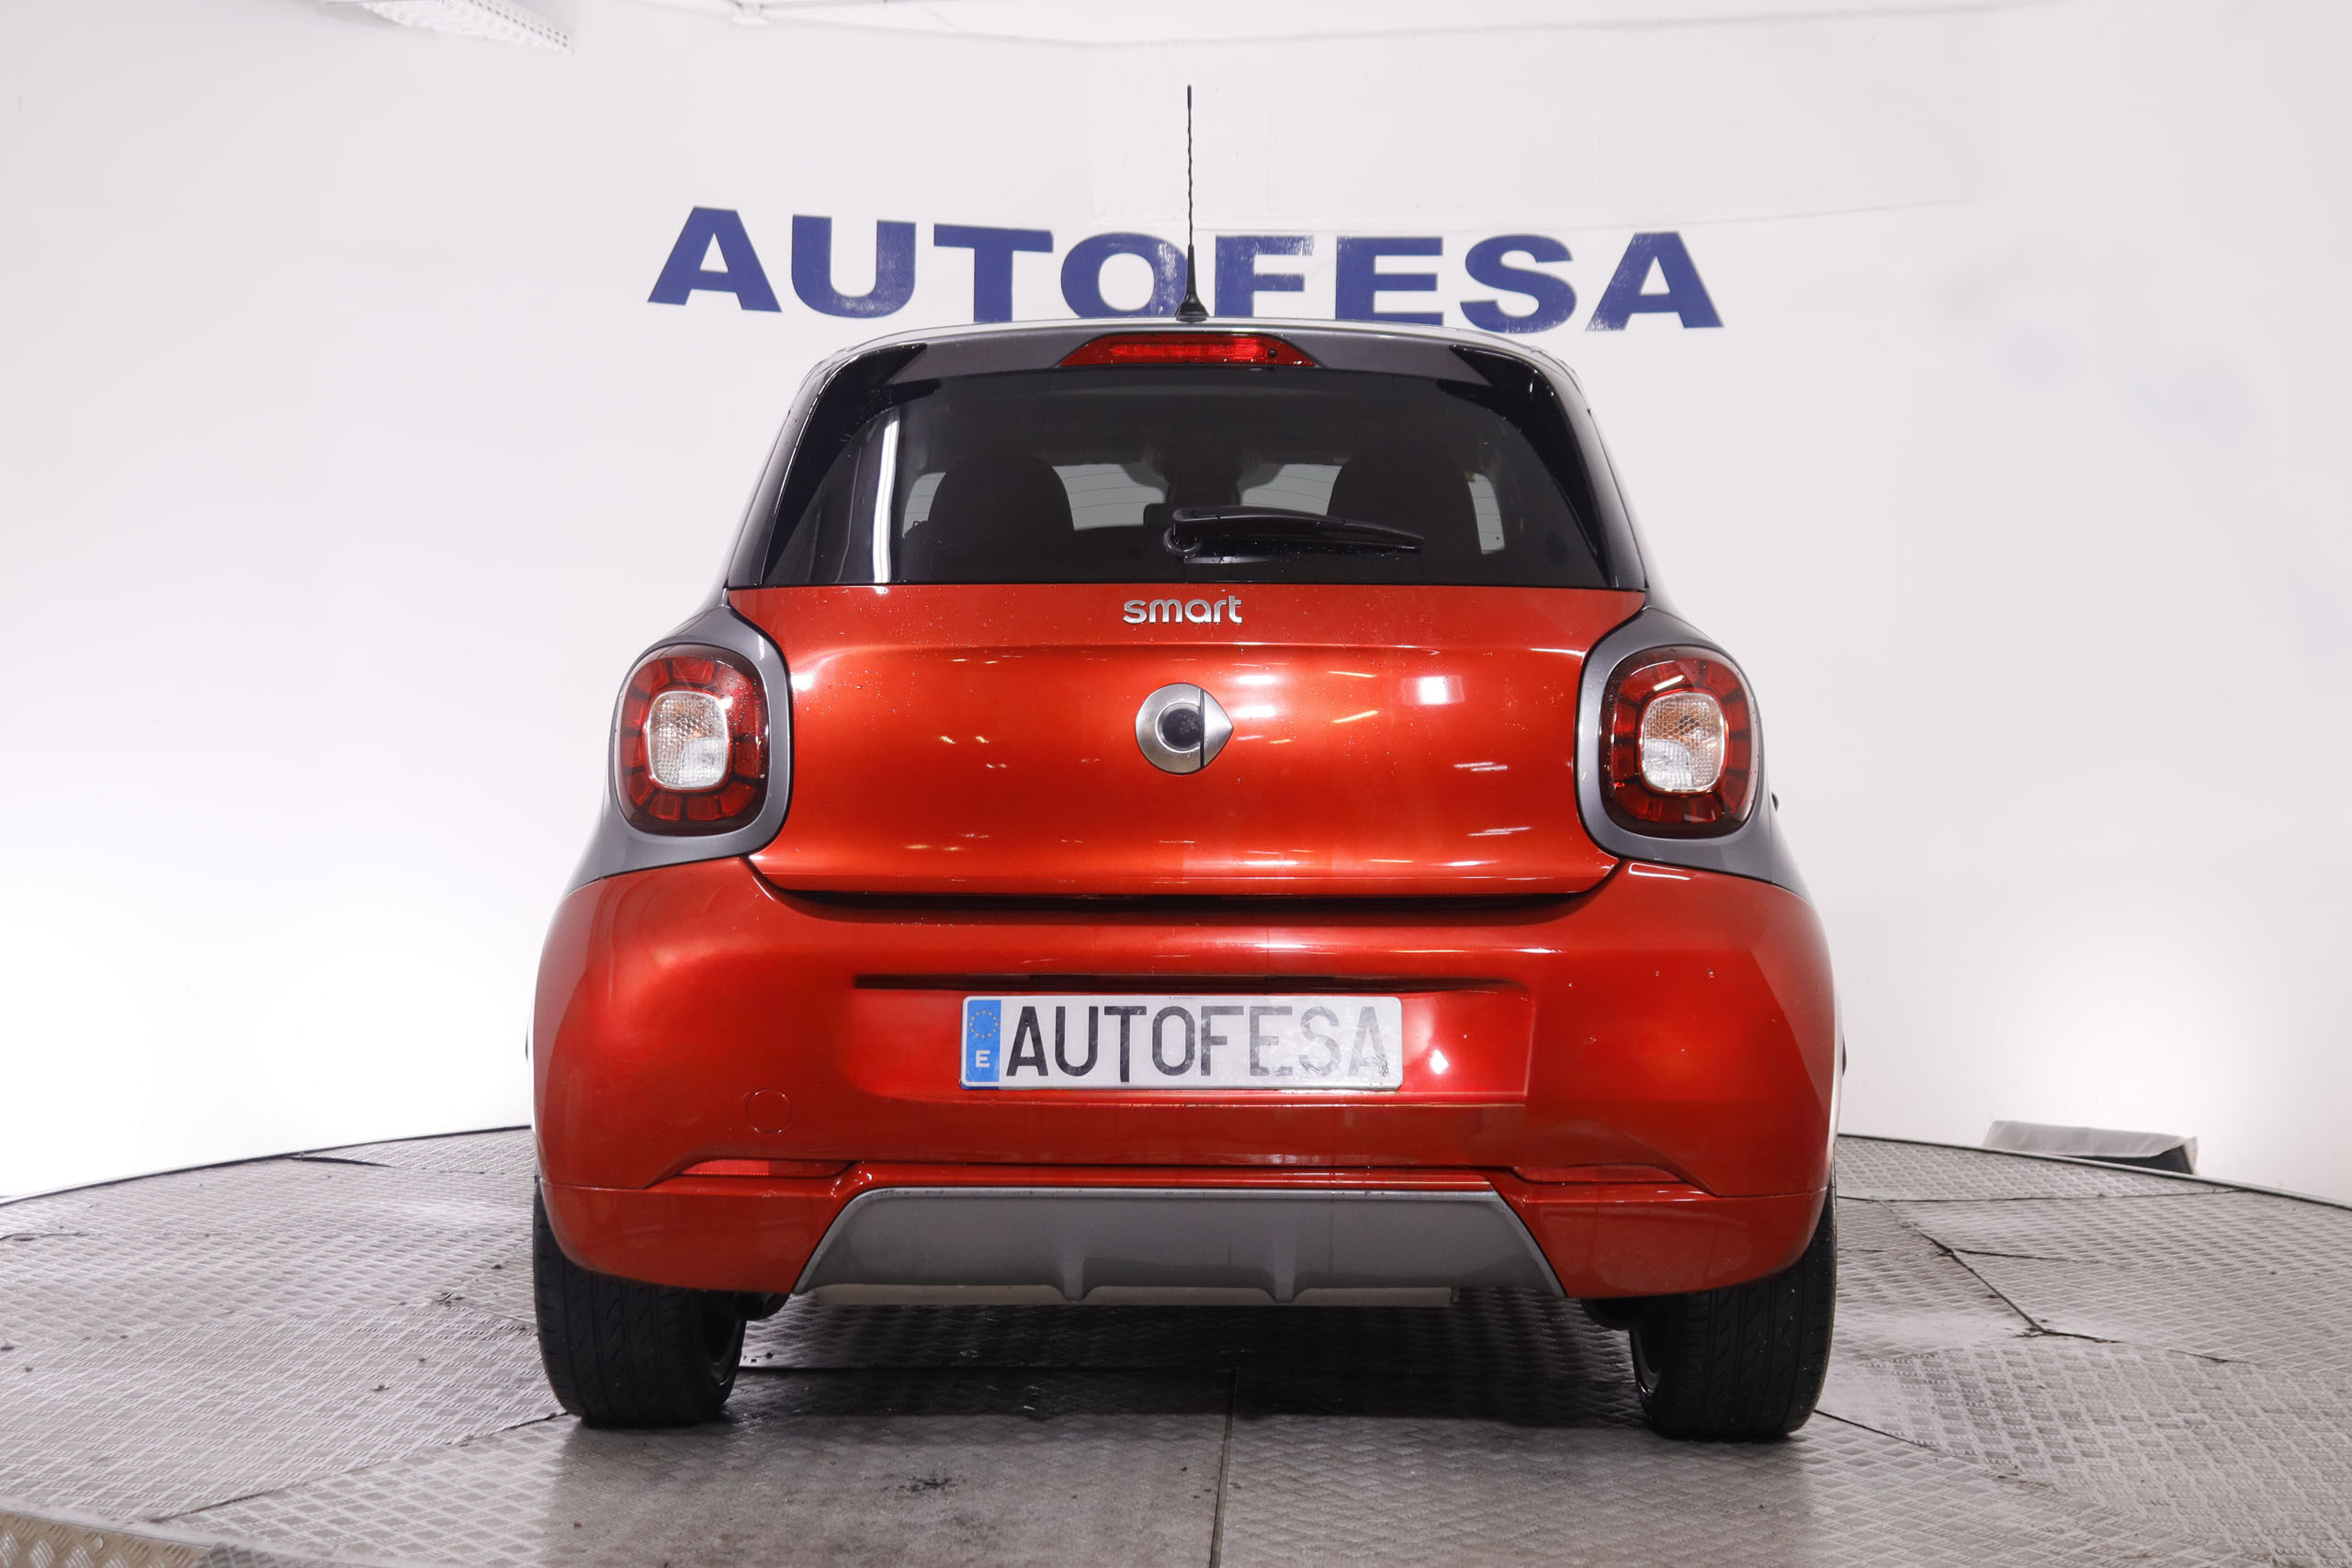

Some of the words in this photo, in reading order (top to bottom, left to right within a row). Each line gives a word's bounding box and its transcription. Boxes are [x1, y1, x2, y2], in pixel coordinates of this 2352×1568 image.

[647, 206, 1724, 333] AUTOFESA
[1123, 595, 1243, 624] smart
[975, 1050, 990, 1068] E
[1006, 1006, 1388, 1083] AUTOFESA
